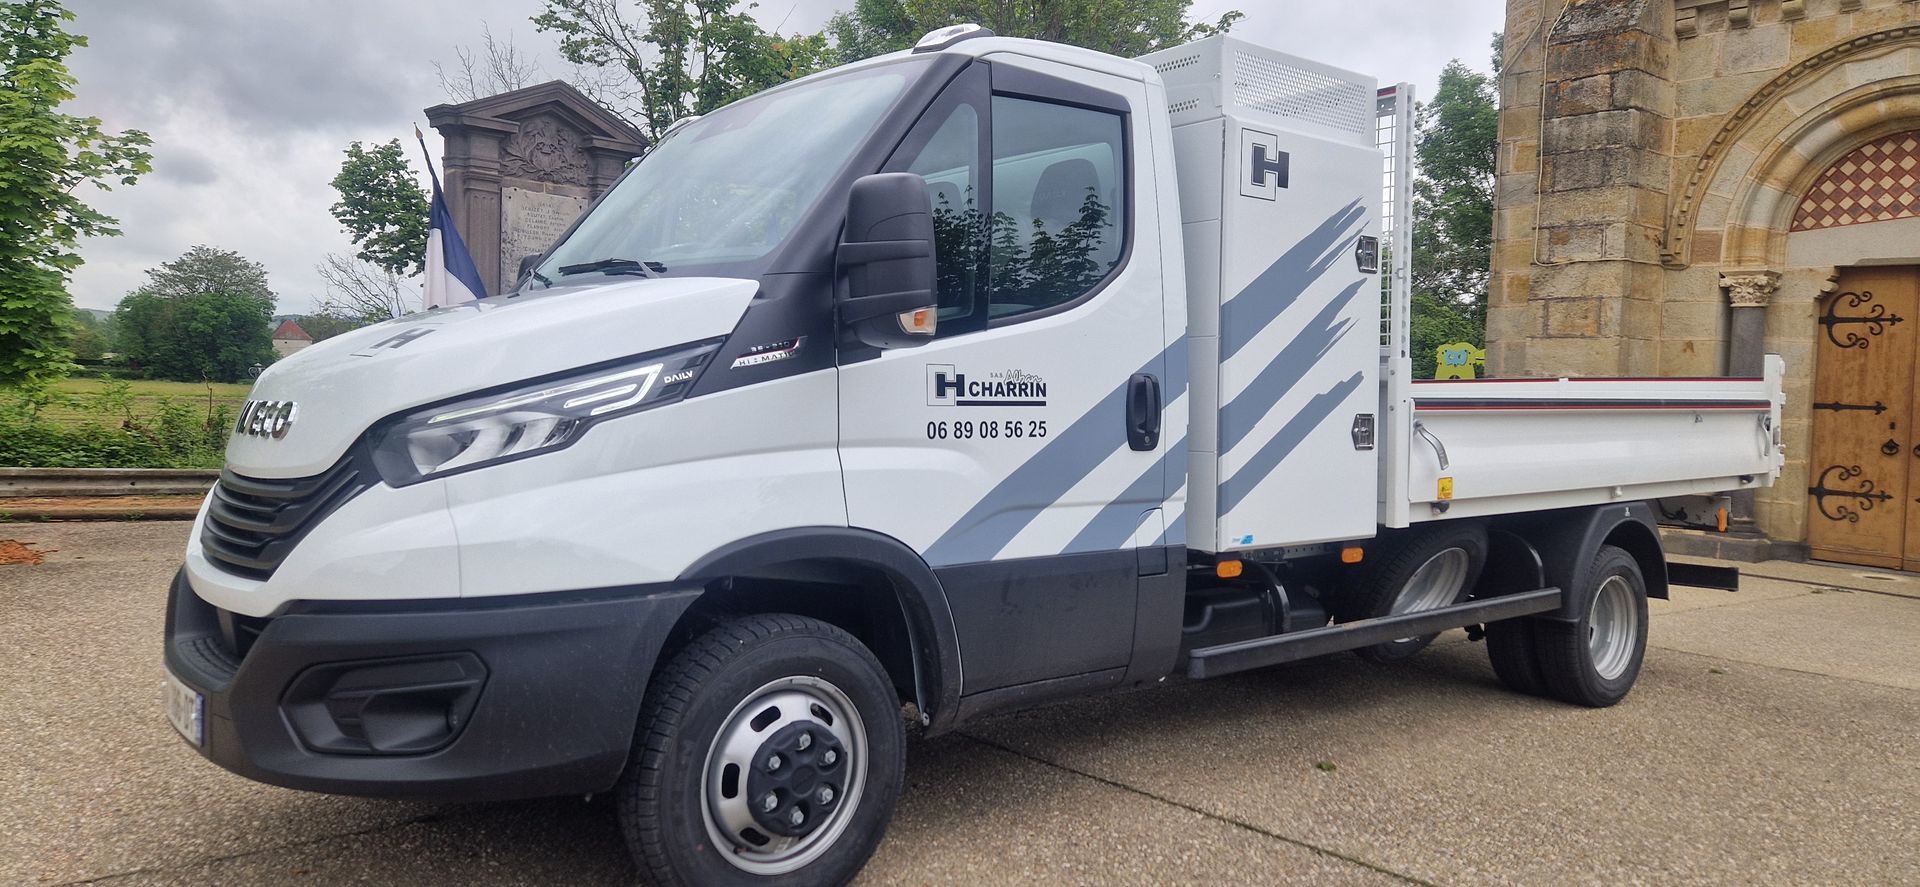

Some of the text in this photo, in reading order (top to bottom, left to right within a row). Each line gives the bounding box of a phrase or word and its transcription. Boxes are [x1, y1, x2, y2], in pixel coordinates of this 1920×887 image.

[663, 370, 694, 384] DAILY
[968, 380, 1047, 398] CHARRIN
[236, 400, 300, 440] IVECO
[927, 420, 1047, 440] 06 89 08 56 25
